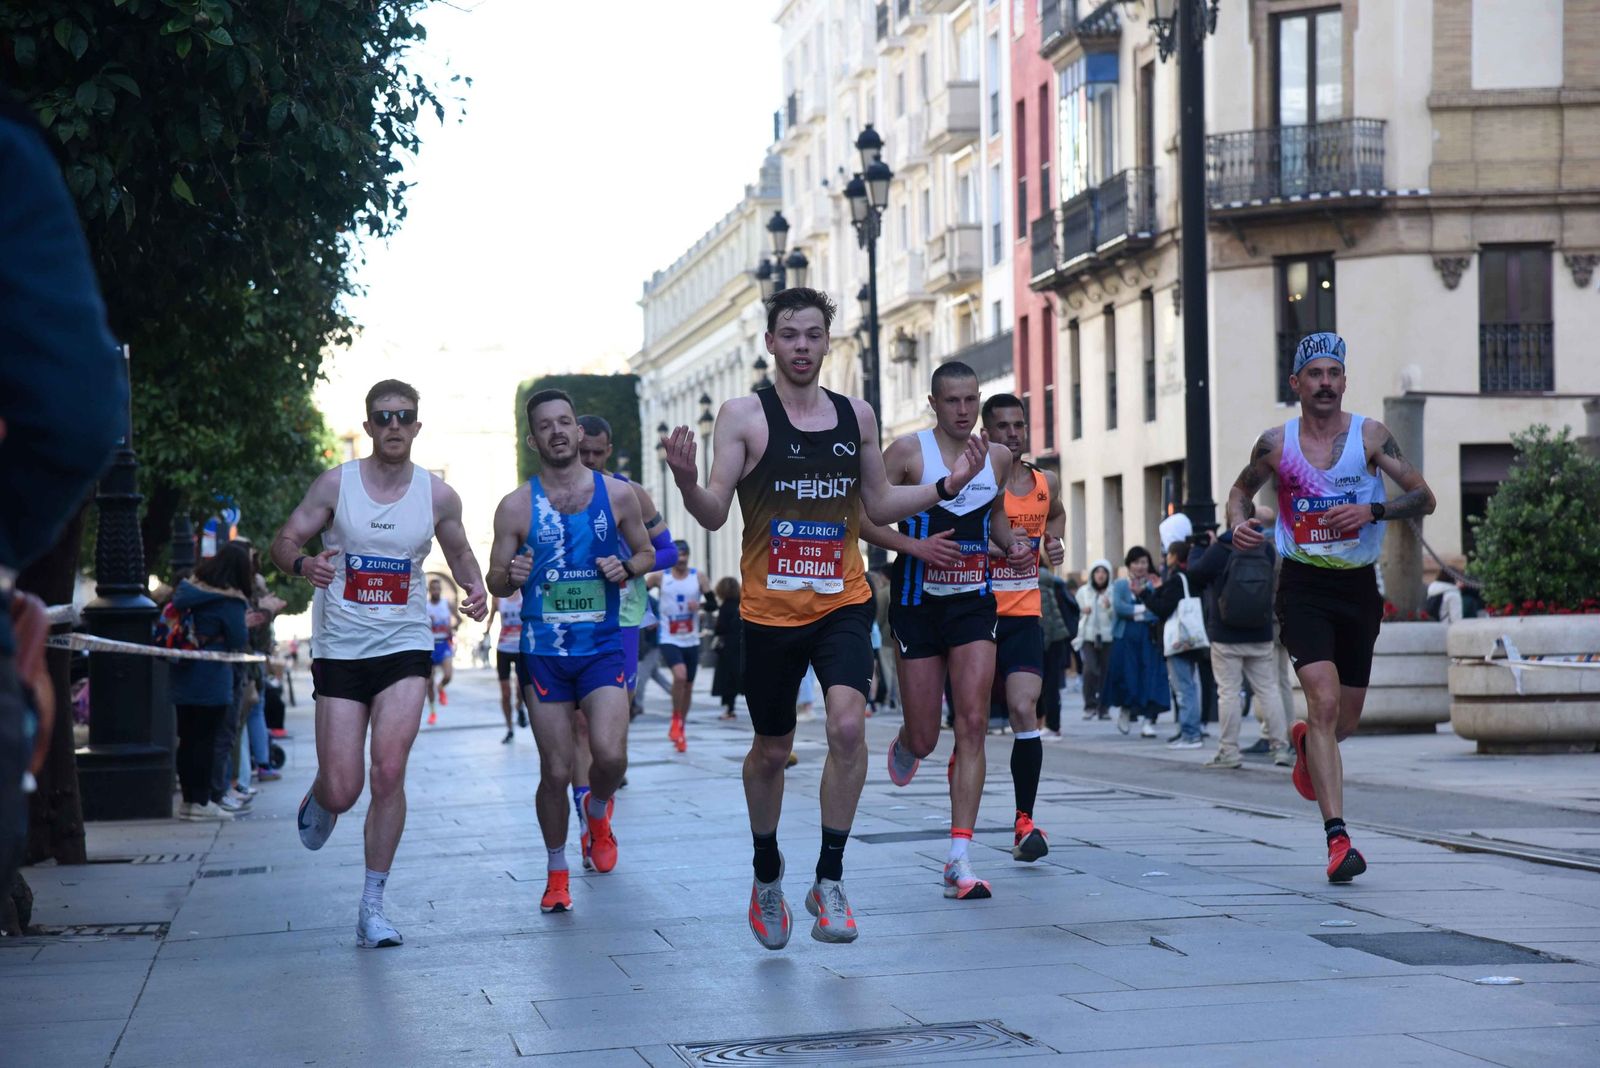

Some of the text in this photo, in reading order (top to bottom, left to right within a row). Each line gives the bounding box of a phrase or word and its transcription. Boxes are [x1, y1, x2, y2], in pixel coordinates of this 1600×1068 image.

[1313, 498, 1349, 508] ZURICH
[370, 522, 396, 530] BANDIT
[799, 525, 838, 536] ZURICH
[799, 546, 821, 557] 1315
[960, 543, 982, 552] RICH
[366, 560, 404, 571] ZURICH
[777, 558, 835, 576] FLORIAN
[563, 569, 597, 579] ZURICH
[927, 569, 983, 582] MATTHIEU
[368, 578, 383, 586] 676
[357, 588, 392, 602] MARK
[567, 587, 581, 595] 463
[555, 597, 594, 611] ELLIOT
